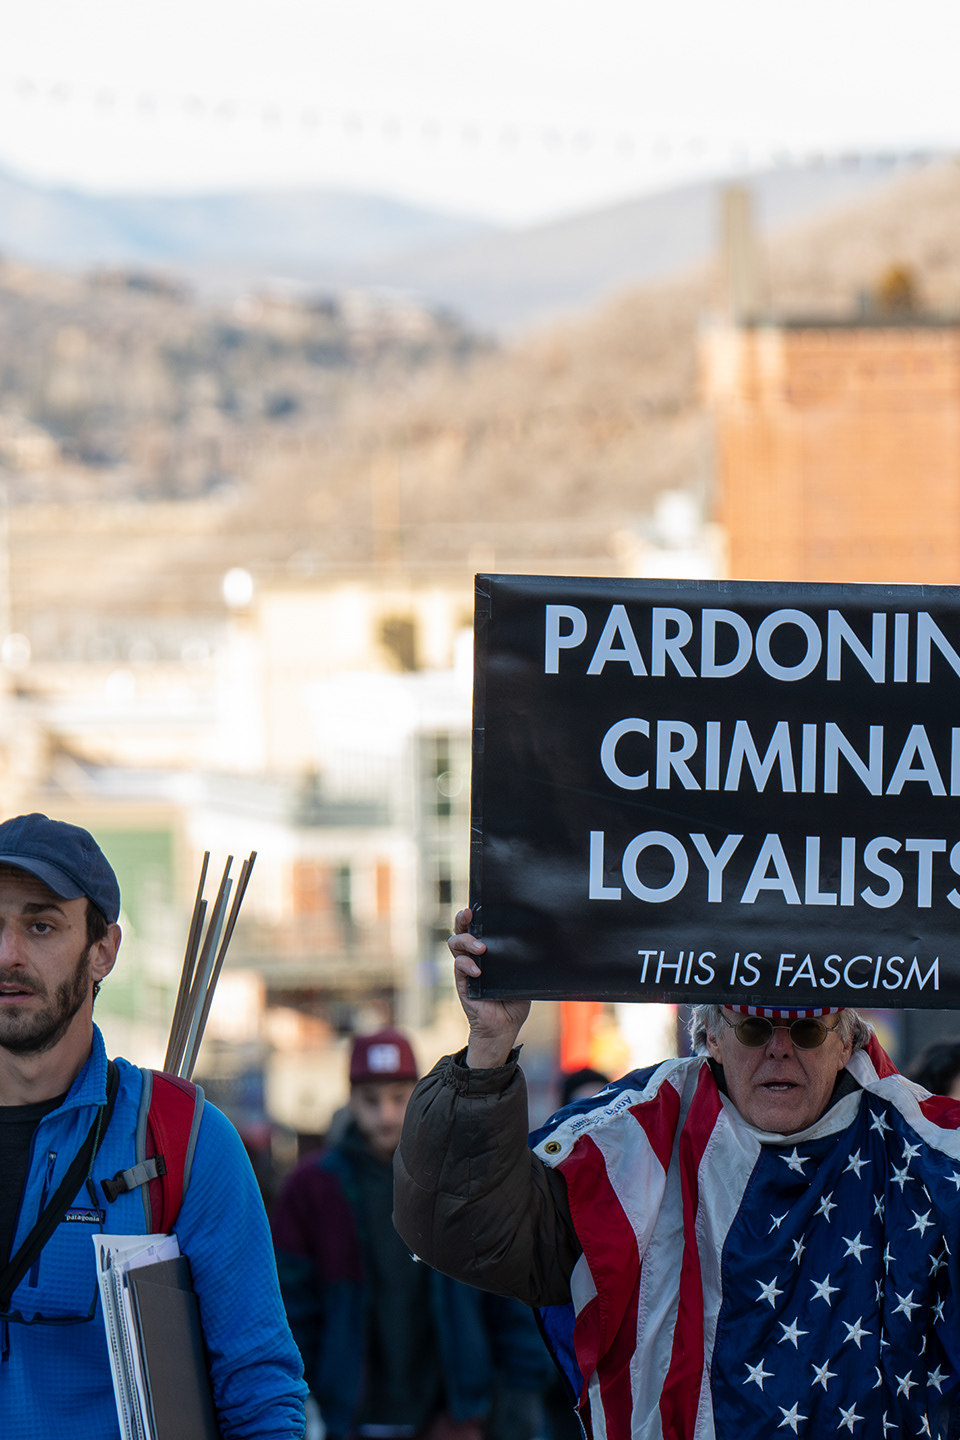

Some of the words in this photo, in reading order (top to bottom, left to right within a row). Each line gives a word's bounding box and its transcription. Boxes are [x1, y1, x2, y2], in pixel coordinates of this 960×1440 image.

[637, 949, 717, 985] THIS
[729, 952, 762, 987] IS
[775, 953, 940, 991] FASCISM
[66, 1214, 100, 1222] patagonia
